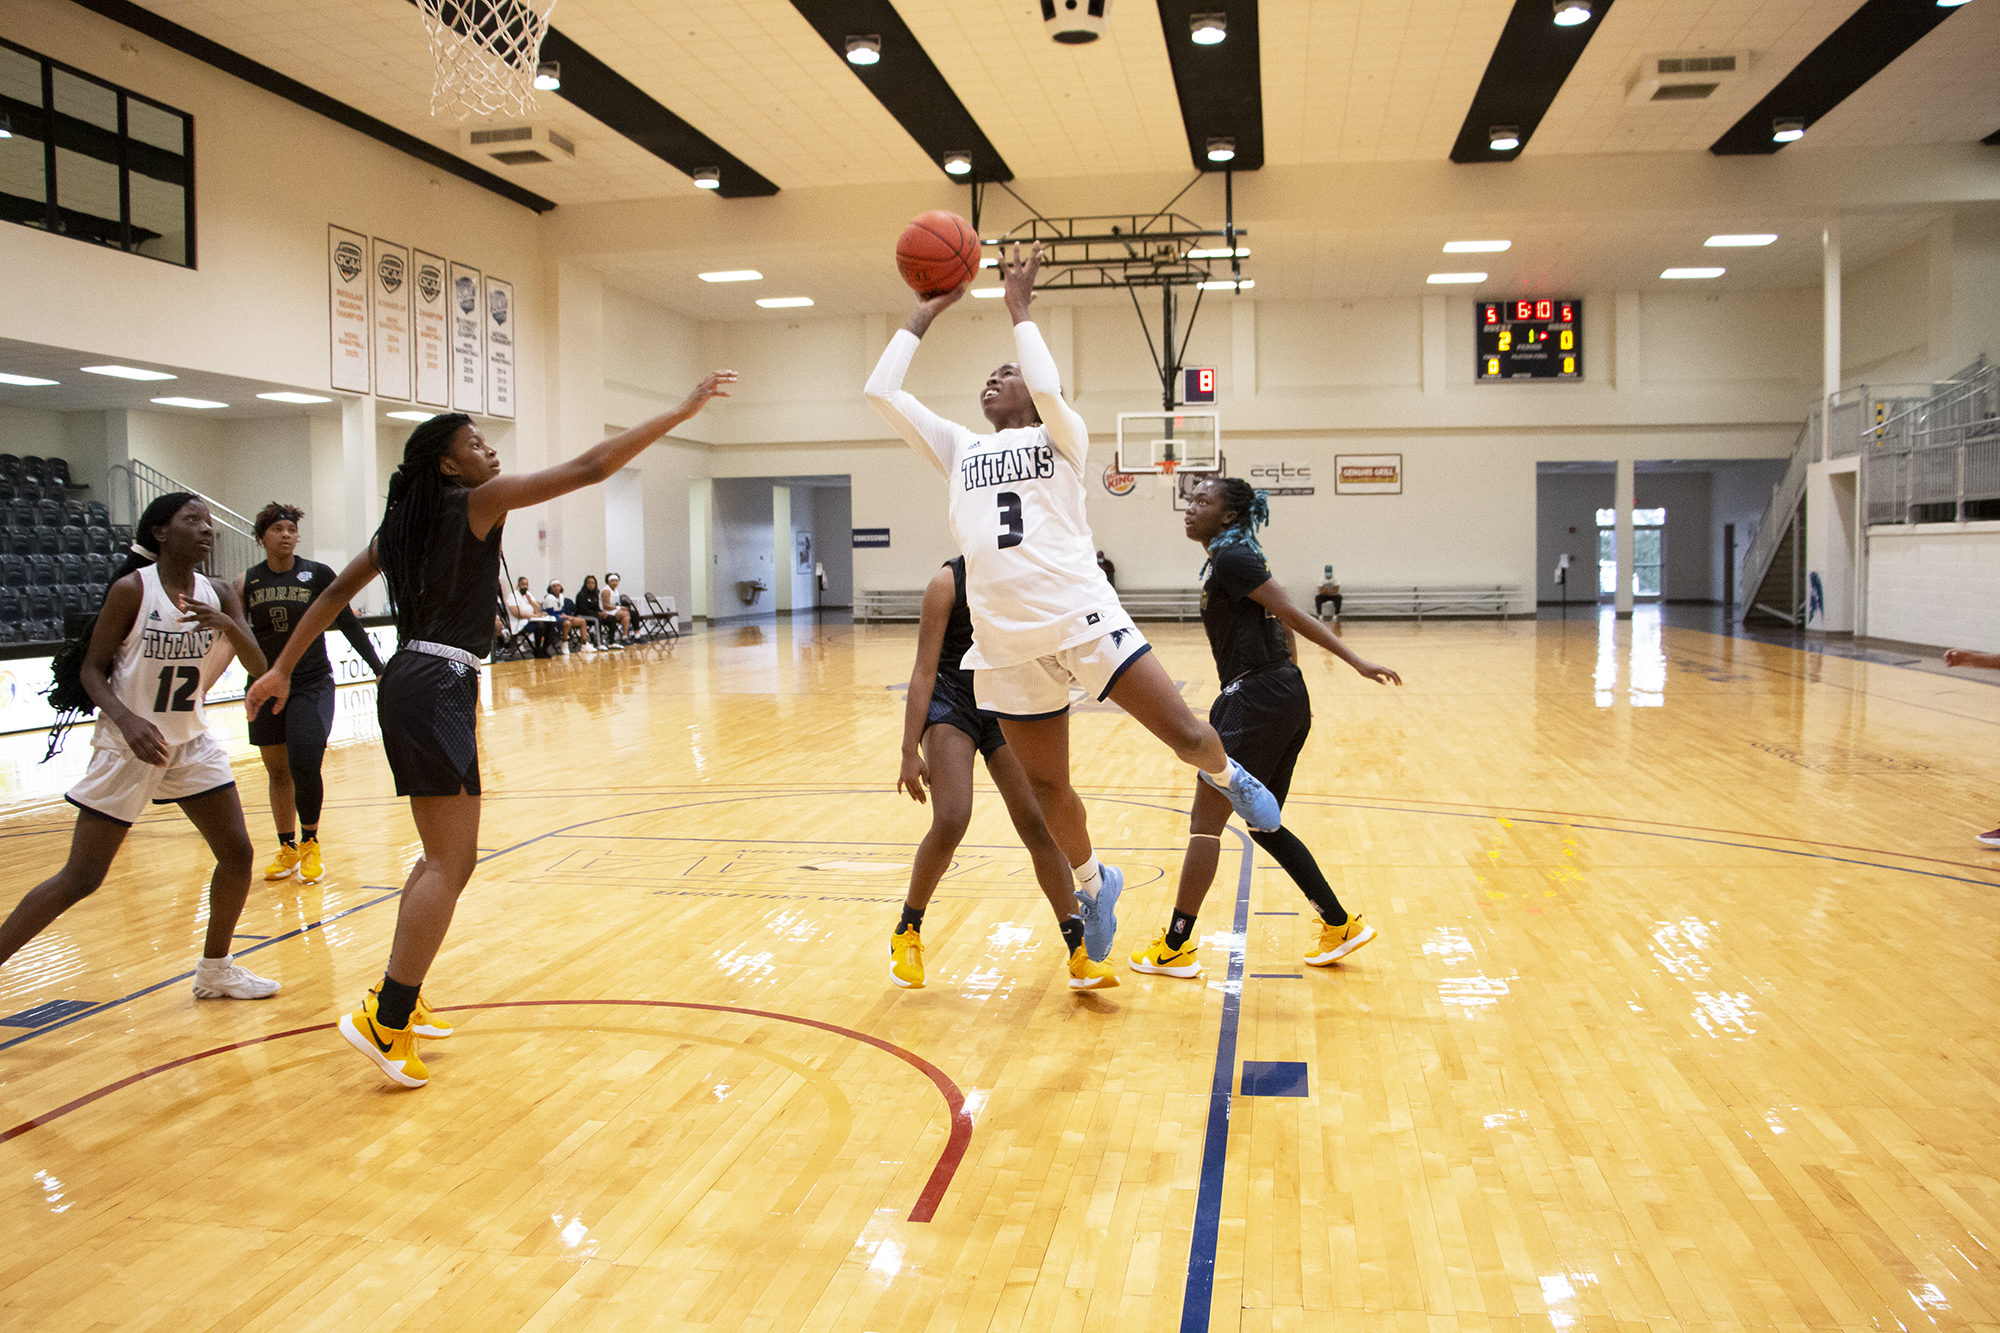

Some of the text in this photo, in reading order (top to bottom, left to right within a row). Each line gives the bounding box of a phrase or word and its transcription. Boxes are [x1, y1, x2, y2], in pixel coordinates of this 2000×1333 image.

[1486, 307, 1498, 324] 5
[1517, 300, 1552, 320] 6:10
[1562, 306, 1573, 323] 5
[1498, 331, 1511, 351] 2
[1560, 330, 1574, 350] 0
[1199, 369, 1214, 393] 8
[961, 445, 1055, 491] TITANS
[1107, 473, 1135, 490] KING
[997, 491, 1024, 550] 3
[249, 586, 312, 608] ANDREW
[269, 606, 289, 632] 2
[143, 628, 214, 660] TITANS
[153, 665, 200, 712] 12
